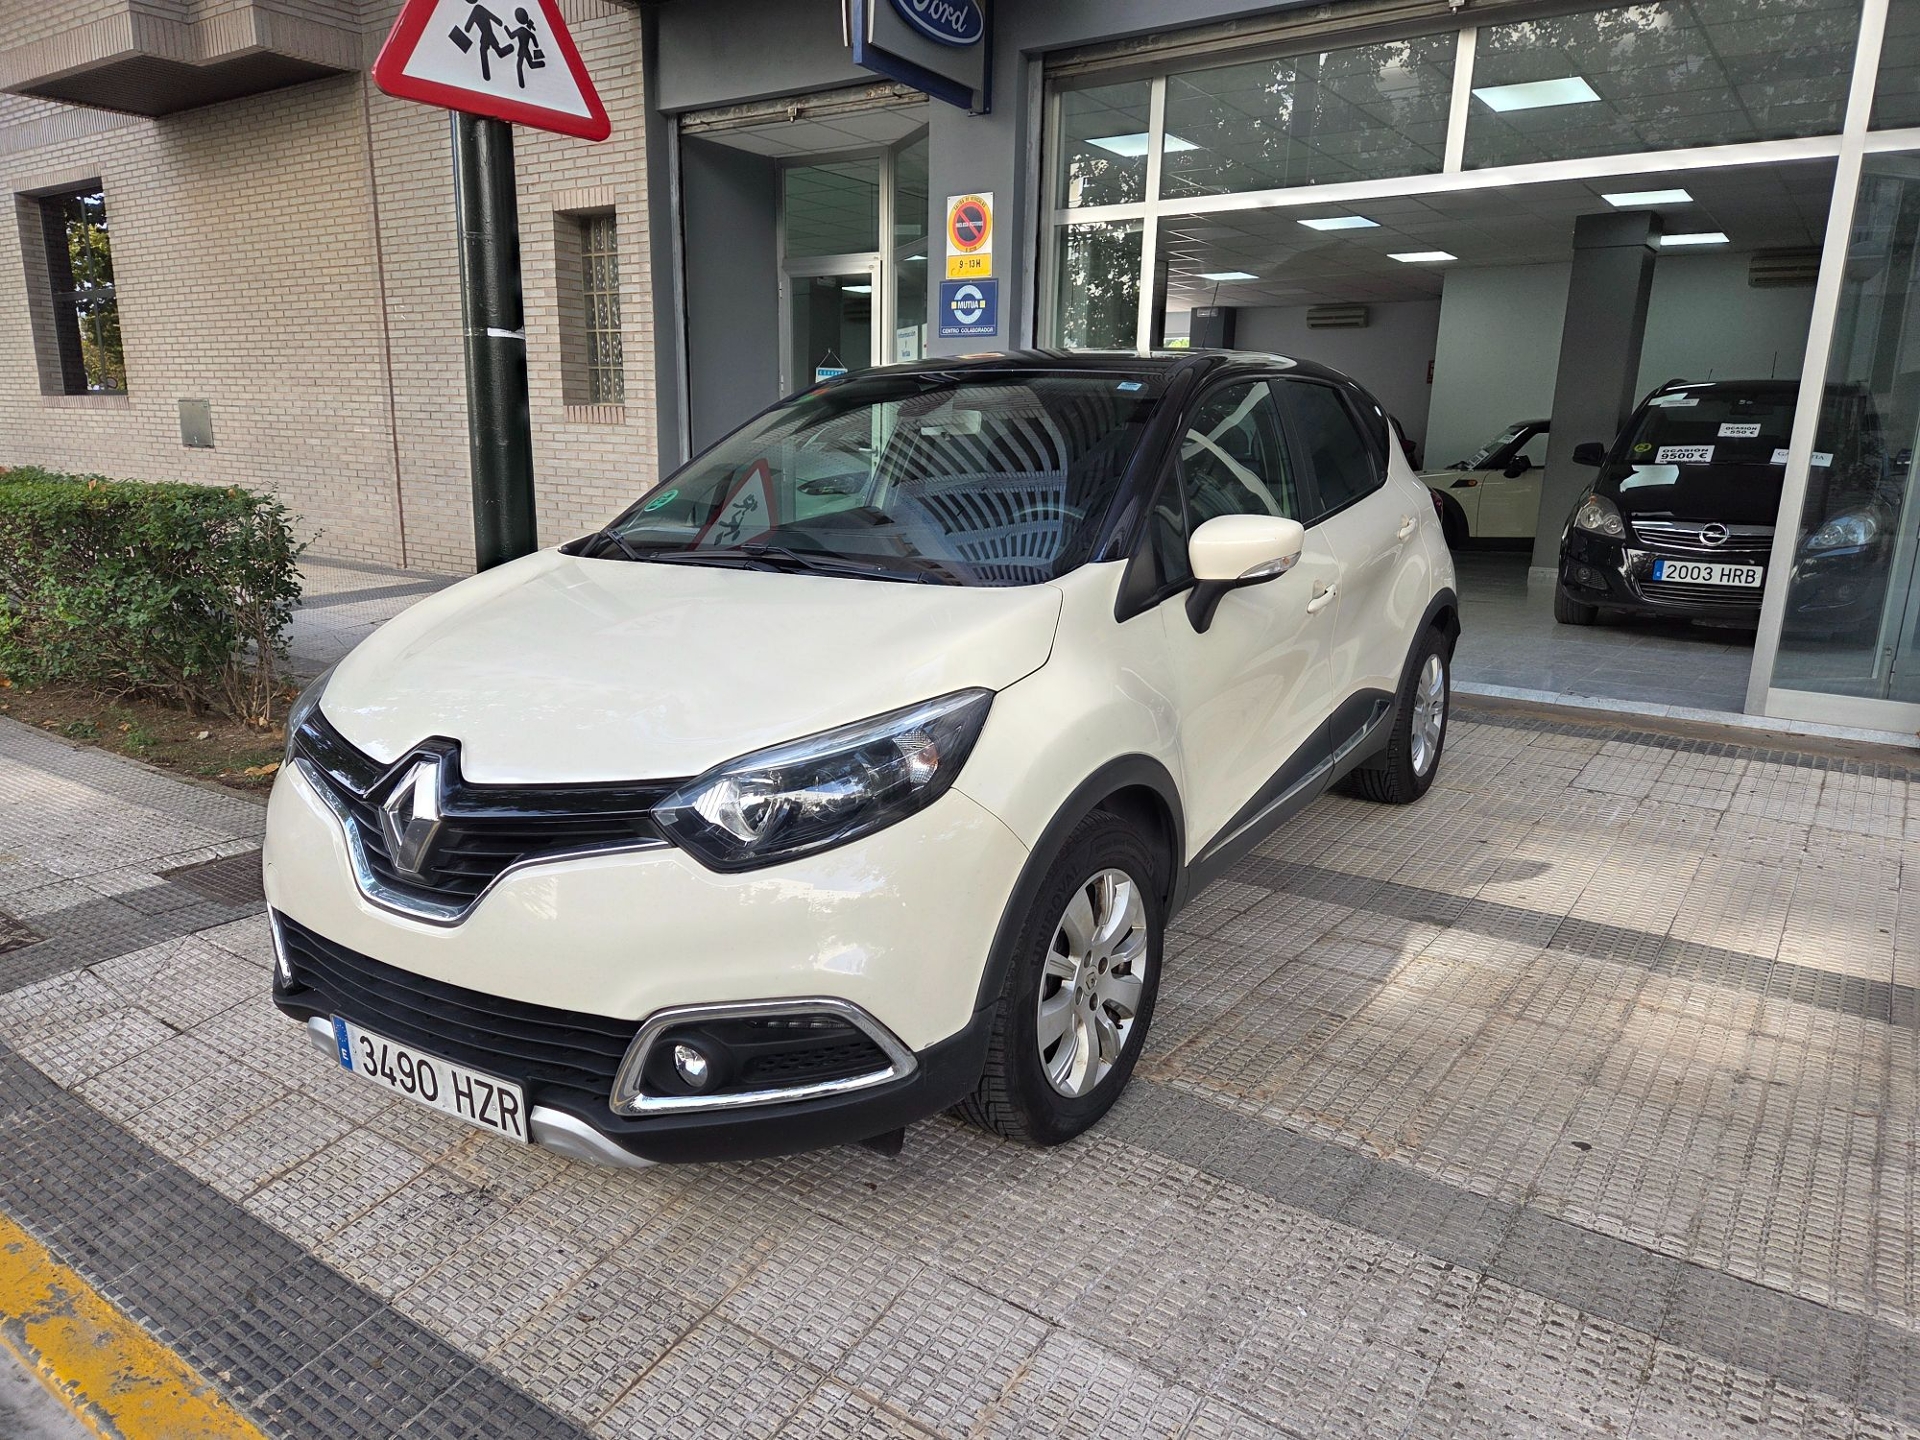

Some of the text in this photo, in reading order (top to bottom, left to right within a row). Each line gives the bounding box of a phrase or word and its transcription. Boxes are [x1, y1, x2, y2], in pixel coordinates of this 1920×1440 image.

[959, 259, 964, 269] 9
[957, 300, 979, 309] MUTUA
[1661, 452, 1694, 460] 9500
[1666, 564, 1713, 581] 2003
[1719, 567, 1757, 584] HRB
[359, 1035, 439, 1102] 3490
[451, 1070, 521, 1137] HZR
